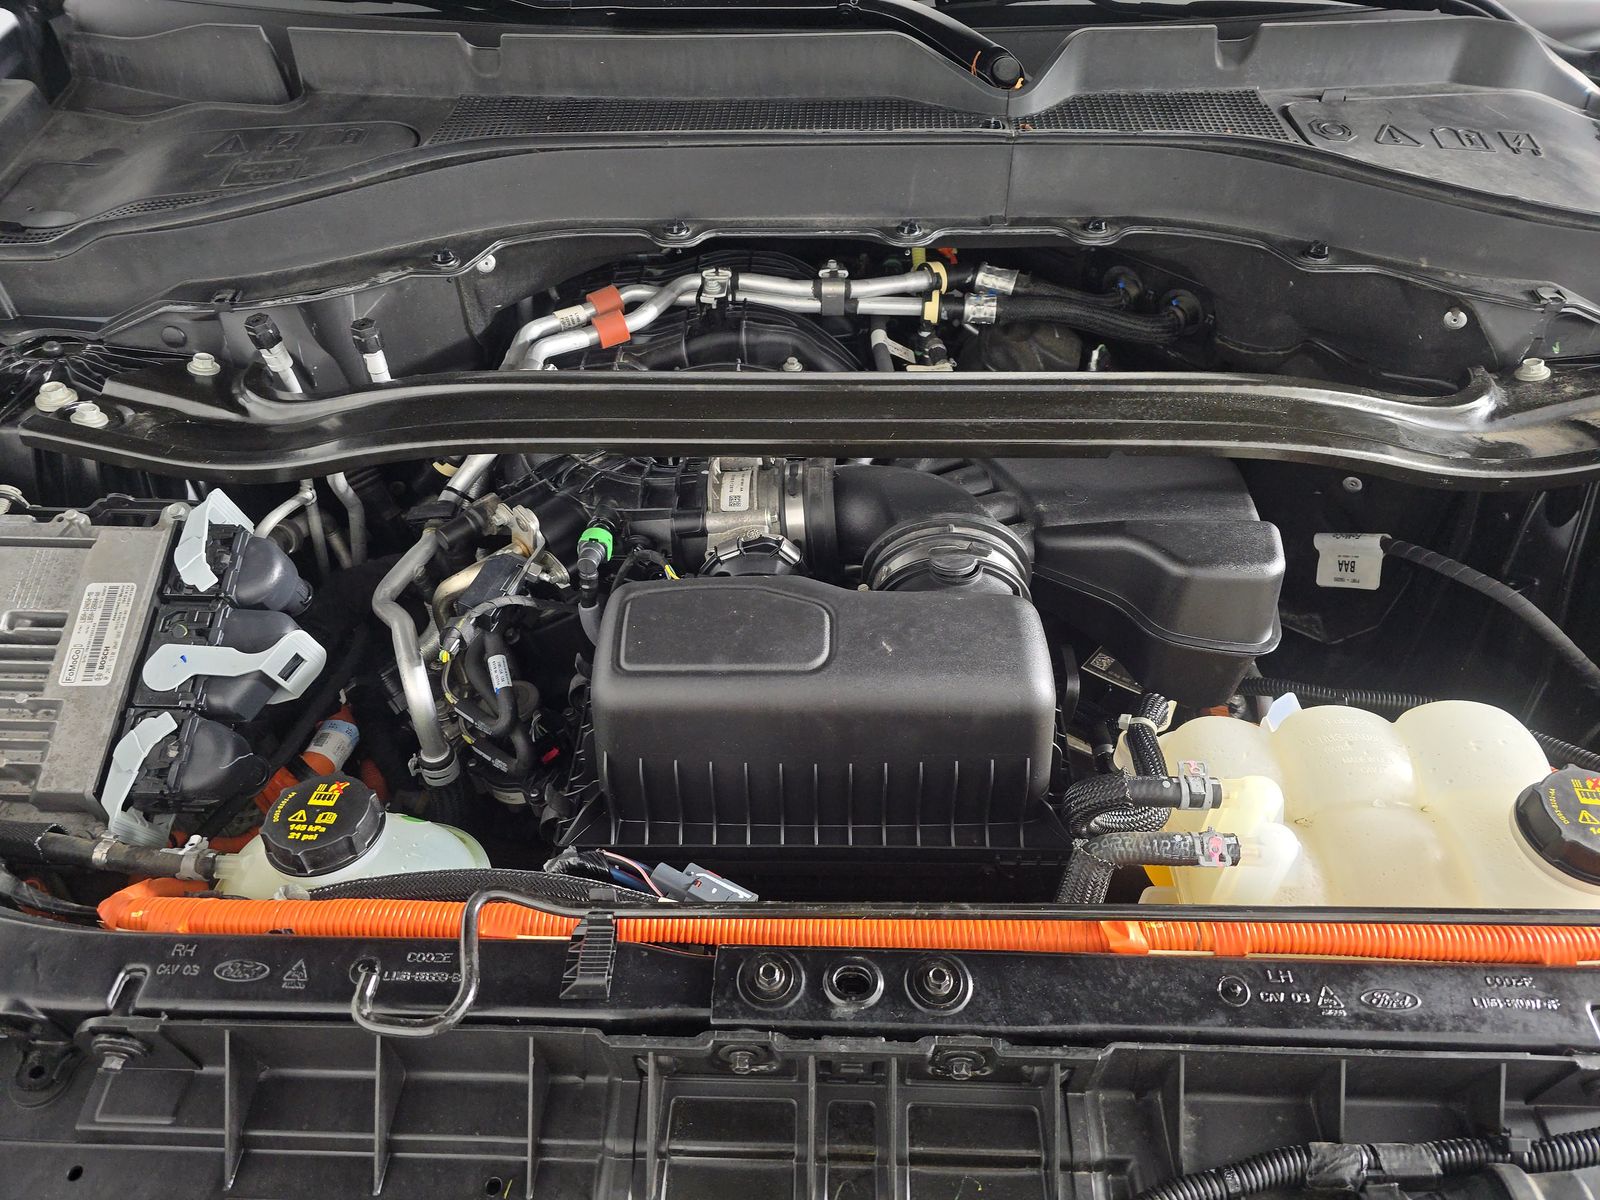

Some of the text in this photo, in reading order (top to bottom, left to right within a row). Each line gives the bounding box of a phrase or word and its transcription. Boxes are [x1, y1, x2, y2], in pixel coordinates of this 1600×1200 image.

[1338, 560, 1356, 573] BAA
[98, 646, 110, 669] BOSCH
[65, 649, 81, 681] FoMoCo
[289, 823, 327, 833] 145 kPa
[287, 832, 301, 840] 21
[171, 943, 198, 957] RH
[1267, 969, 1293, 983] LH
